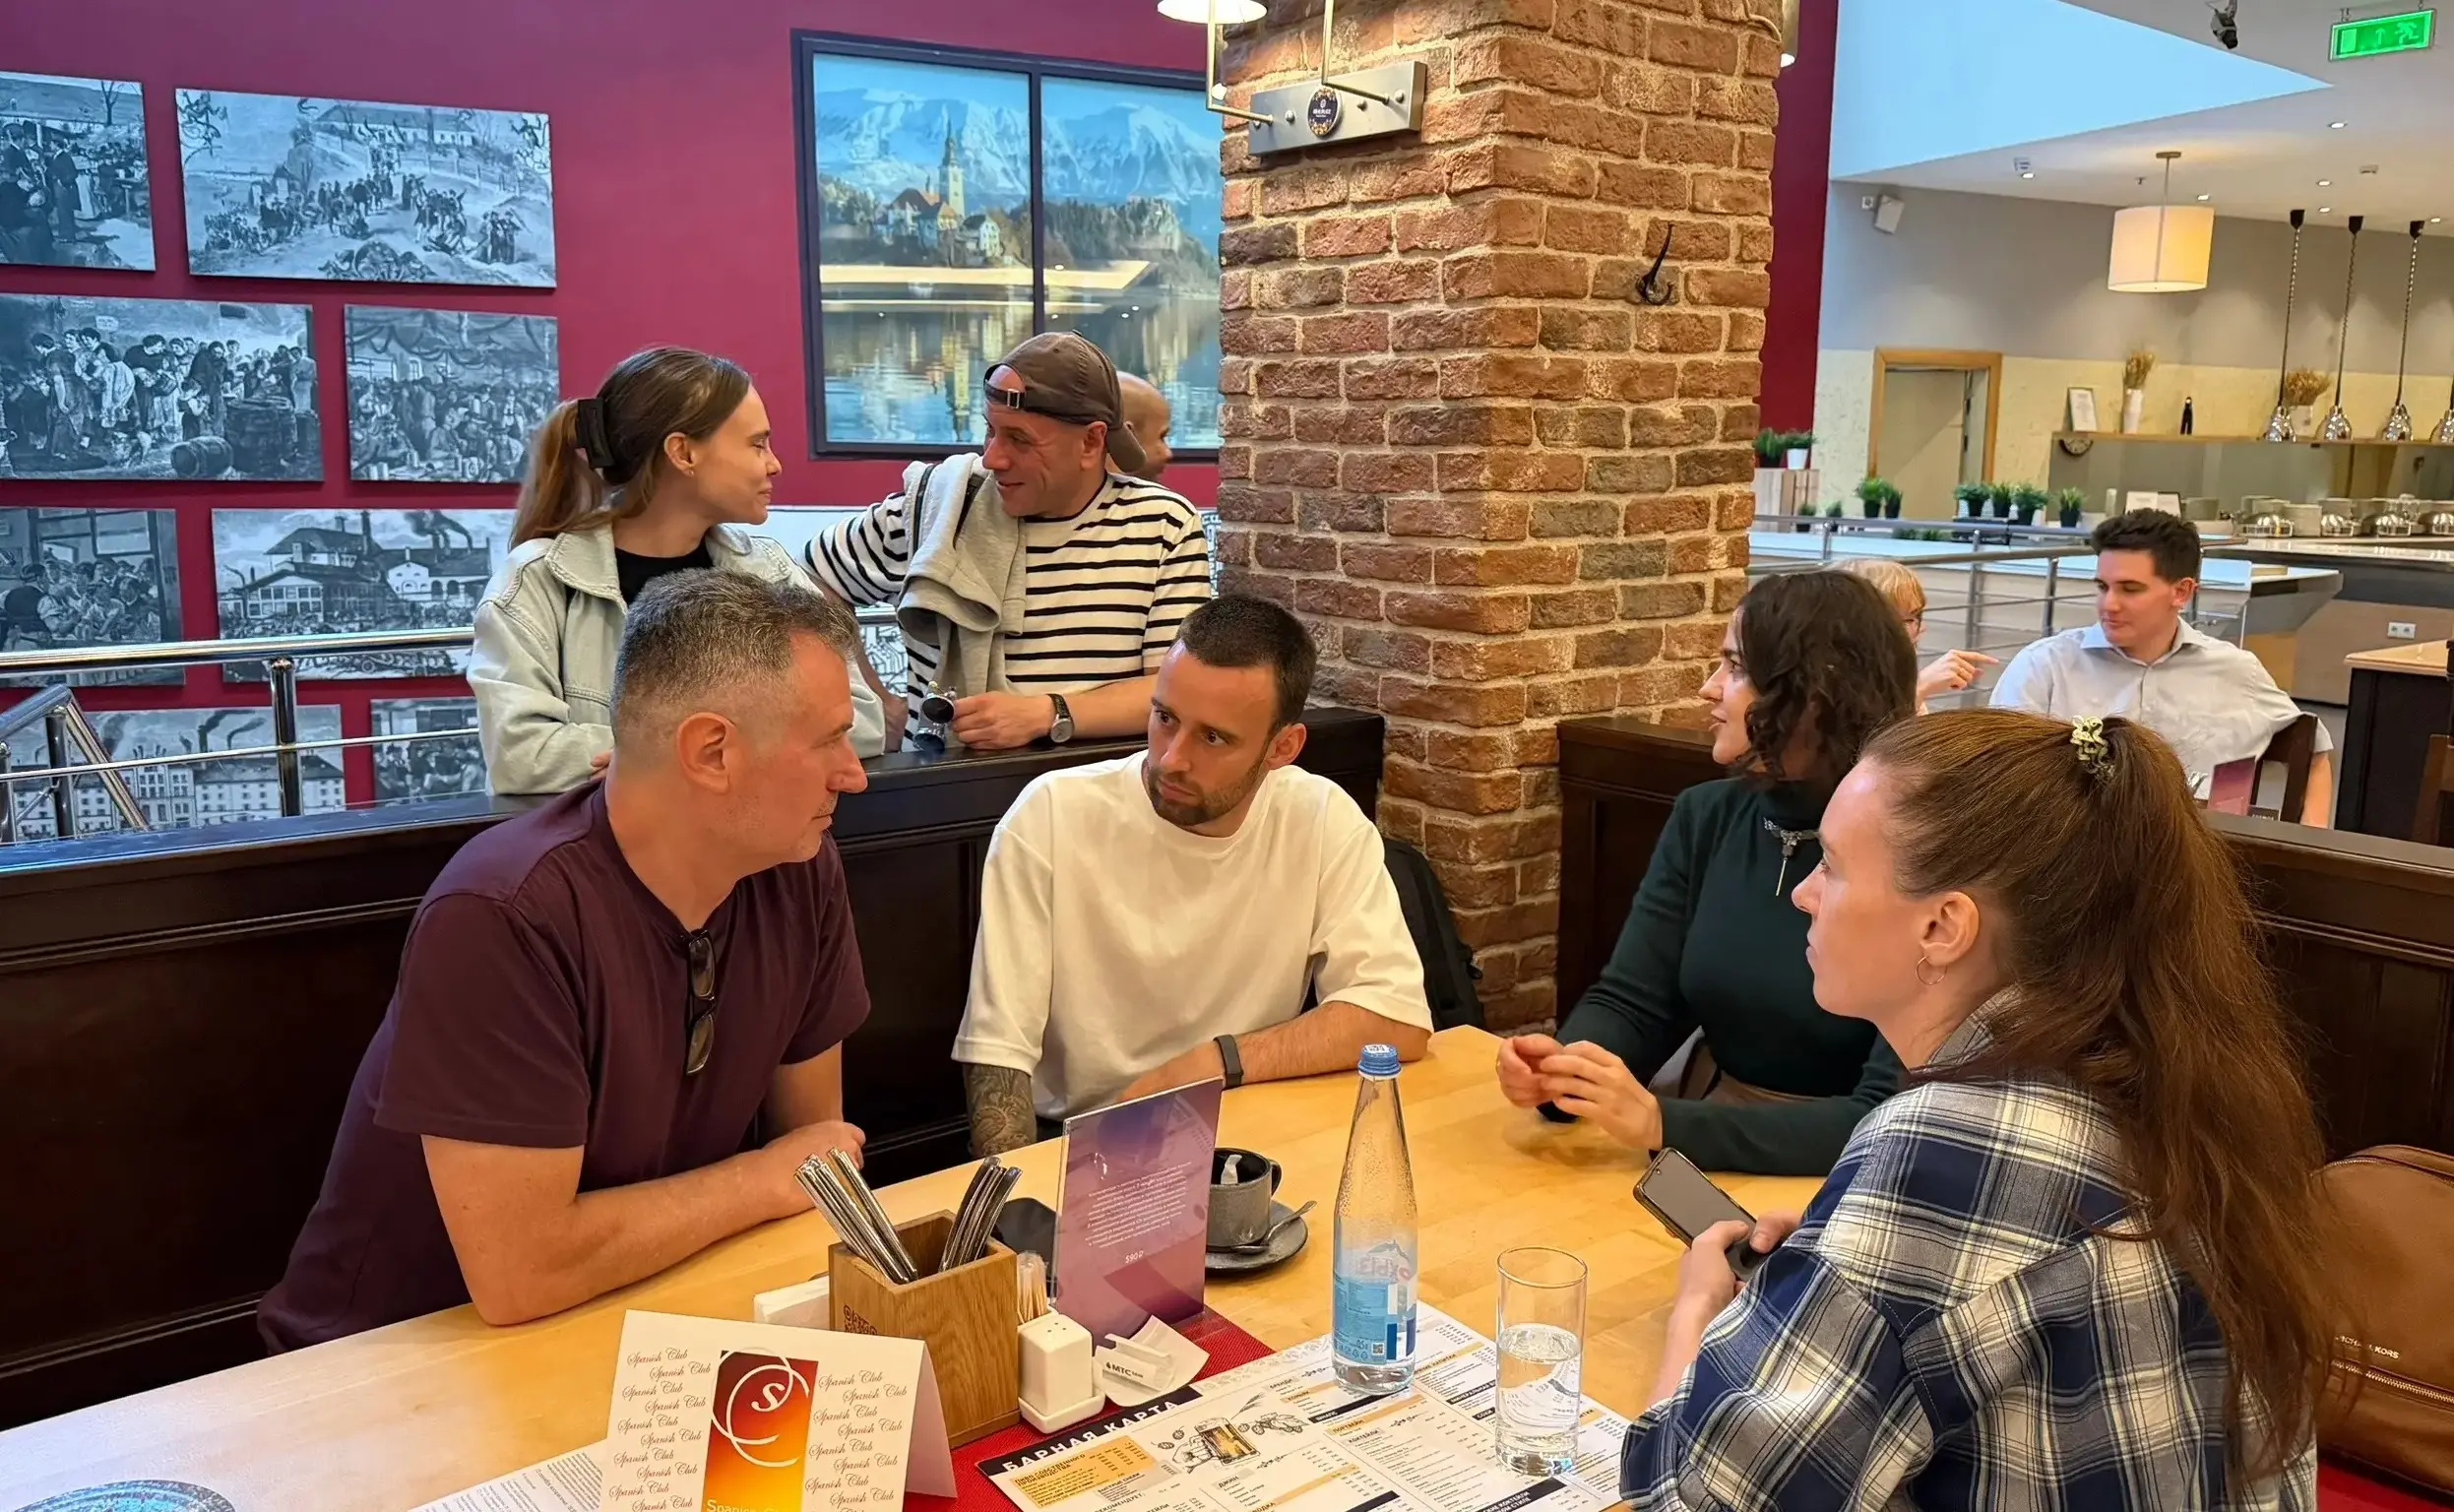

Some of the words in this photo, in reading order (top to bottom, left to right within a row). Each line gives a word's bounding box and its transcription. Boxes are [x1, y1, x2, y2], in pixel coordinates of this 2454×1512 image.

[627, 1352, 661, 1367] Spanish
[665, 1348, 687, 1360] Club
[2374, 1346, 2400, 1359] KORS
[650, 1366, 684, 1381] Spanish
[688, 1361, 711, 1375] Club
[818, 1374, 855, 1391] Spanish
[859, 1370, 882, 1383] Club
[622, 1385, 657, 1401] Spanish
[661, 1381, 683, 1395] Club
[843, 1388, 879, 1405] Spanish
[883, 1384, 907, 1398] Club
[645, 1400, 679, 1416] Spanish
[683, 1395, 706, 1409] Club
[813, 1410, 850, 1426] Spanish
[853, 1405, 878, 1418] Club
[618, 1418, 653, 1434] Spanish
[656, 1415, 678, 1427] Club
[838, 1423, 874, 1439] Spanish
[878, 1418, 903, 1432] Club
[641, 1432, 675, 1448] Spanish
[679, 1428, 701, 1442] Club
[1002, 1431, 1098, 1472] БАРНАЯ
[1103, 1401, 1179, 1433] КАРТА
[614, 1452, 649, 1468] Spanish
[652, 1448, 674, 1461] Club
[809, 1444, 847, 1460] Spanish
[849, 1439, 873, 1452] Club
[637, 1466, 671, 1481] Spanish
[674, 1462, 697, 1475] Club
[834, 1457, 870, 1473] Spanish
[874, 1453, 898, 1467] Club
[609, 1484, 644, 1500] Spanish
[646, 1480, 669, 1493] Club
[805, 1478, 843, 1494] Spanish
[845, 1474, 868, 1487] Club
[632, 1499, 666, 1512] Spanish
[670, 1495, 693, 1509] Club
[830, 1491, 866, 1508] Spanish
[870, 1487, 894, 1501] Club
